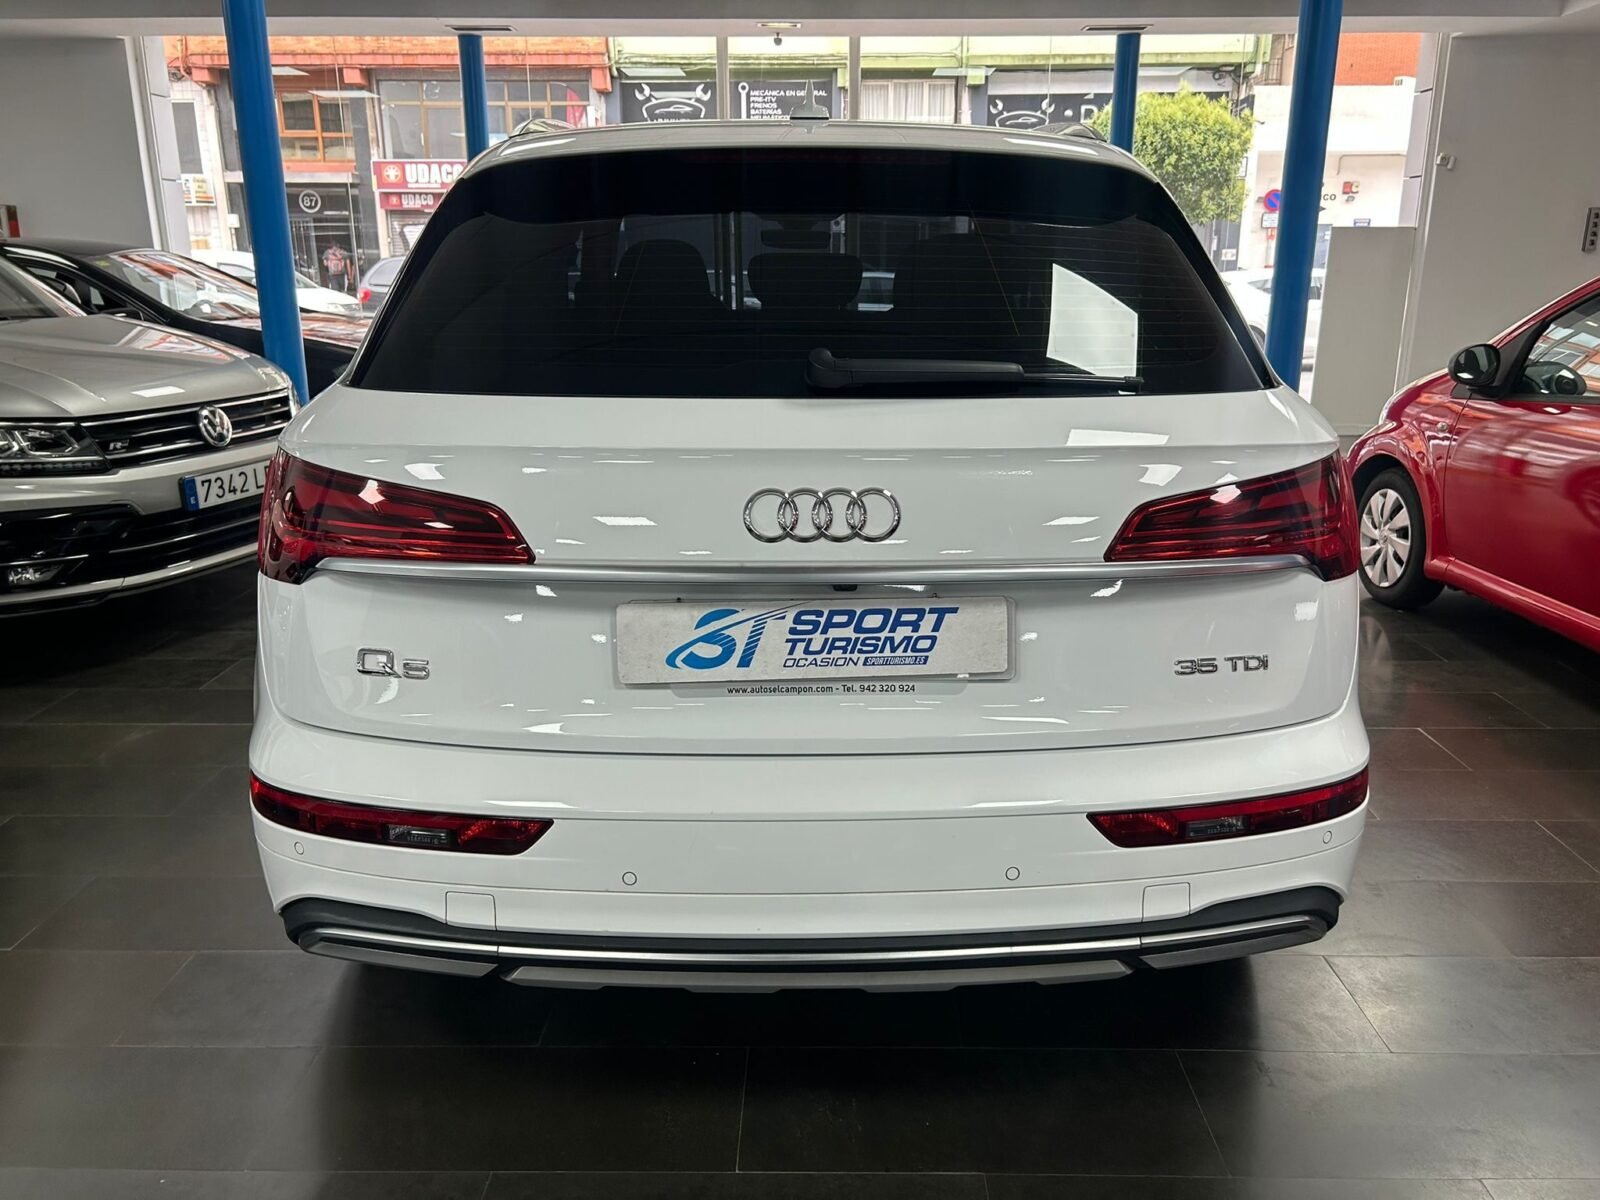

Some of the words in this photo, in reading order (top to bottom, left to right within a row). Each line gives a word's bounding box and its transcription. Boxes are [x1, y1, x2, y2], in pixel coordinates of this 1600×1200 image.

[303, 197, 316, 207] 87
[401, 194, 434, 206] UDACO
[201, 471, 249, 503] 7342
[253, 466, 269, 489] L
[788, 606, 960, 636] SPORT
[784, 635, 938, 656] TURISMO
[357, 648, 430, 680] Q5
[782, 656, 860, 668] OCASION
[865, 656, 926, 665] SPORTTURISMO.ES
[1174, 657, 1218, 675] 35
[727, 685, 833, 694] www.autoselcampon.com
[841, 684, 857, 692] Tel.
[859, 684, 877, 692] 942
[878, 684, 896, 692] 320
[898, 684, 915, 692] 924
